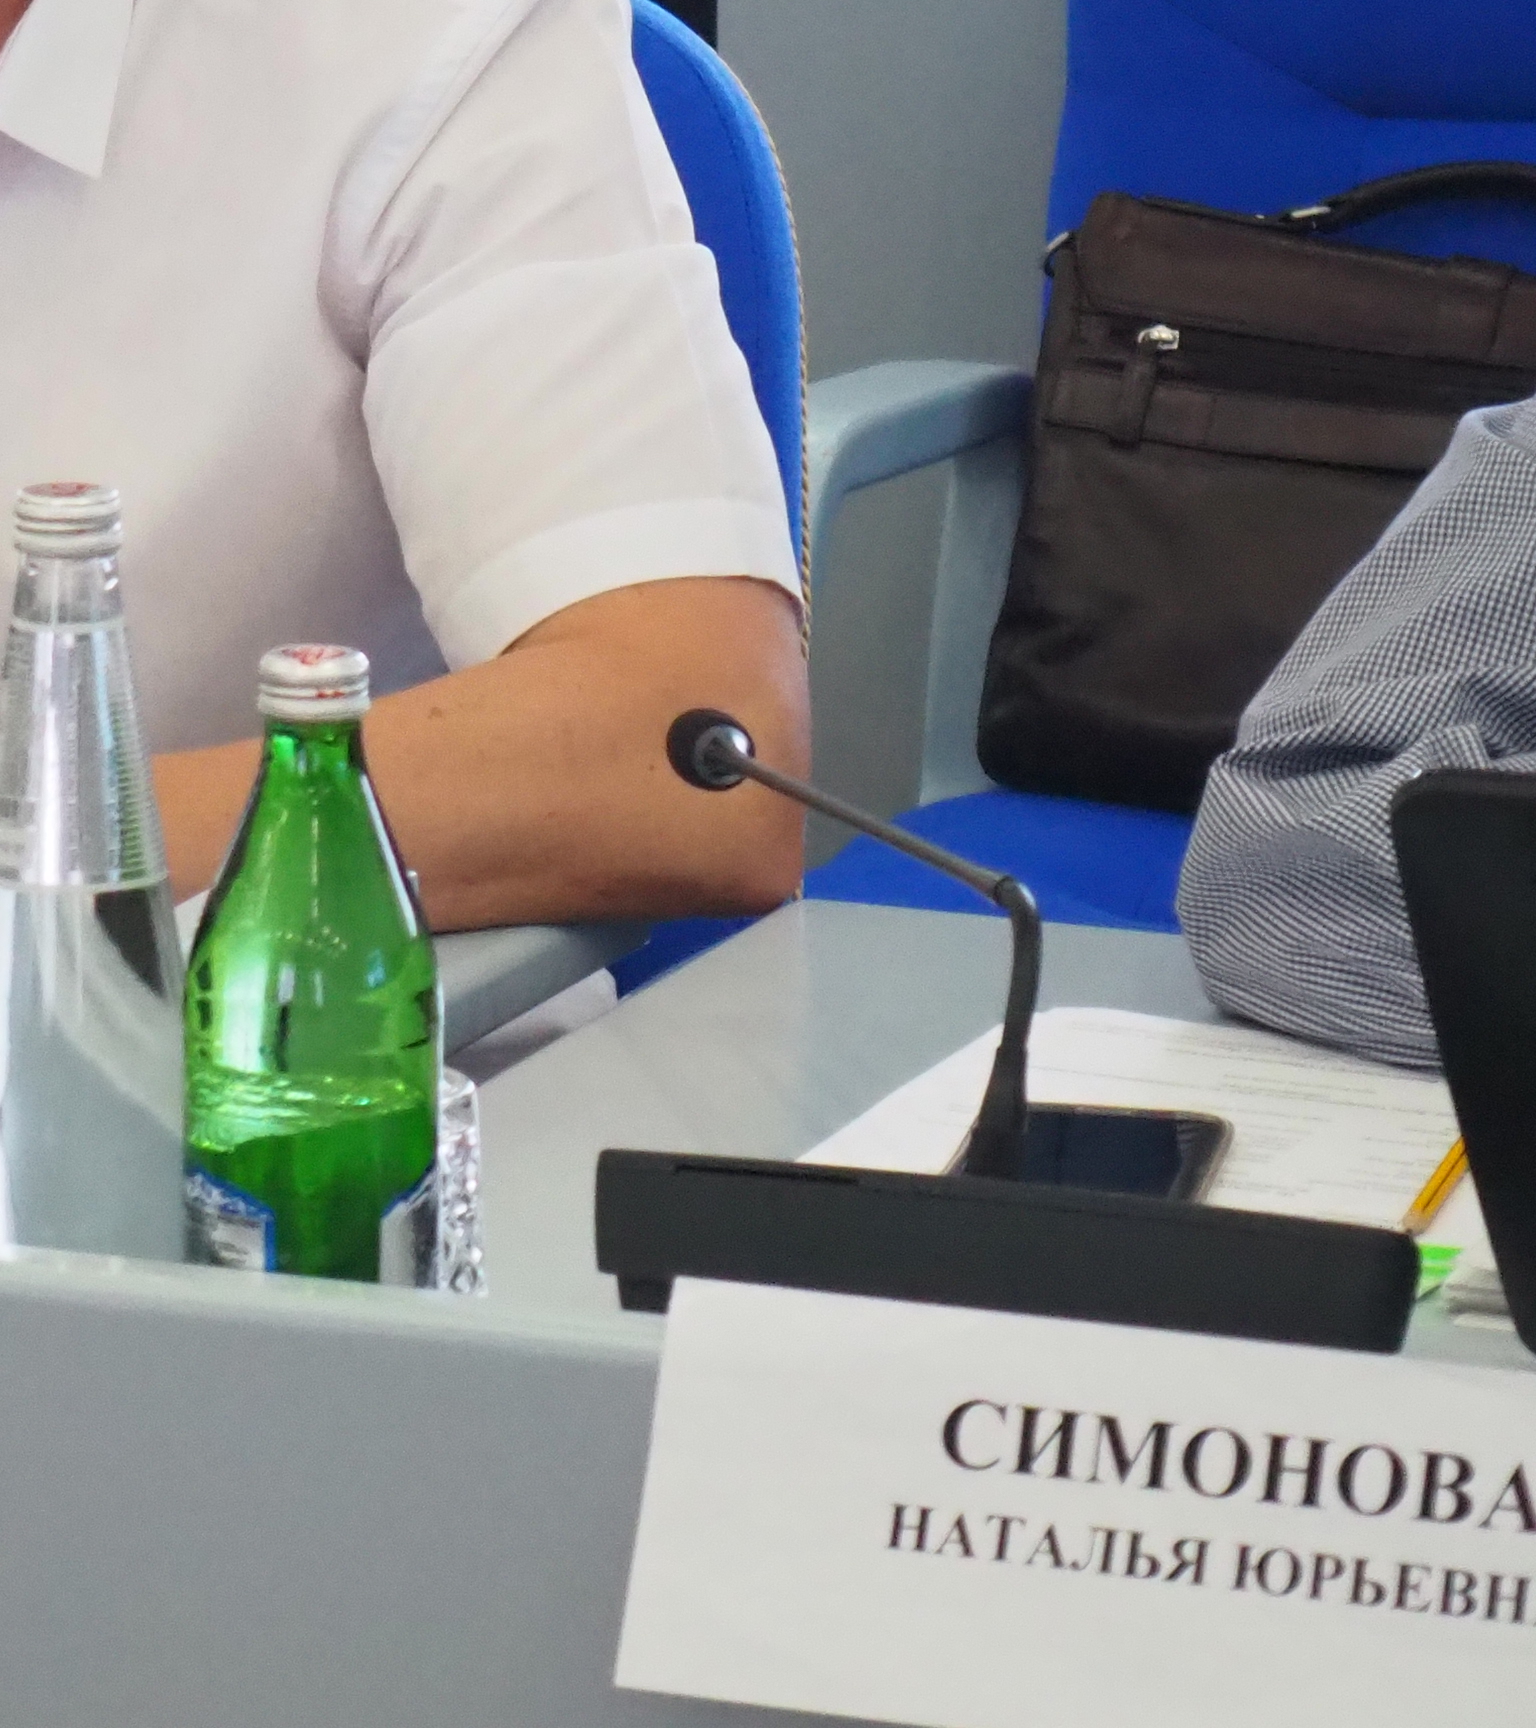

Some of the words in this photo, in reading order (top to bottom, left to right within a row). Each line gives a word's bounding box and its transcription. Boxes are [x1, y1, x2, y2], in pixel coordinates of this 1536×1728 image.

[941, 1398, 1536, 1534] СИМОНОВА
[885, 1503, 1210, 1585] НАТАЛЬЯ
[1230, 1543, 1536, 1626] ЮРЬЕВН
